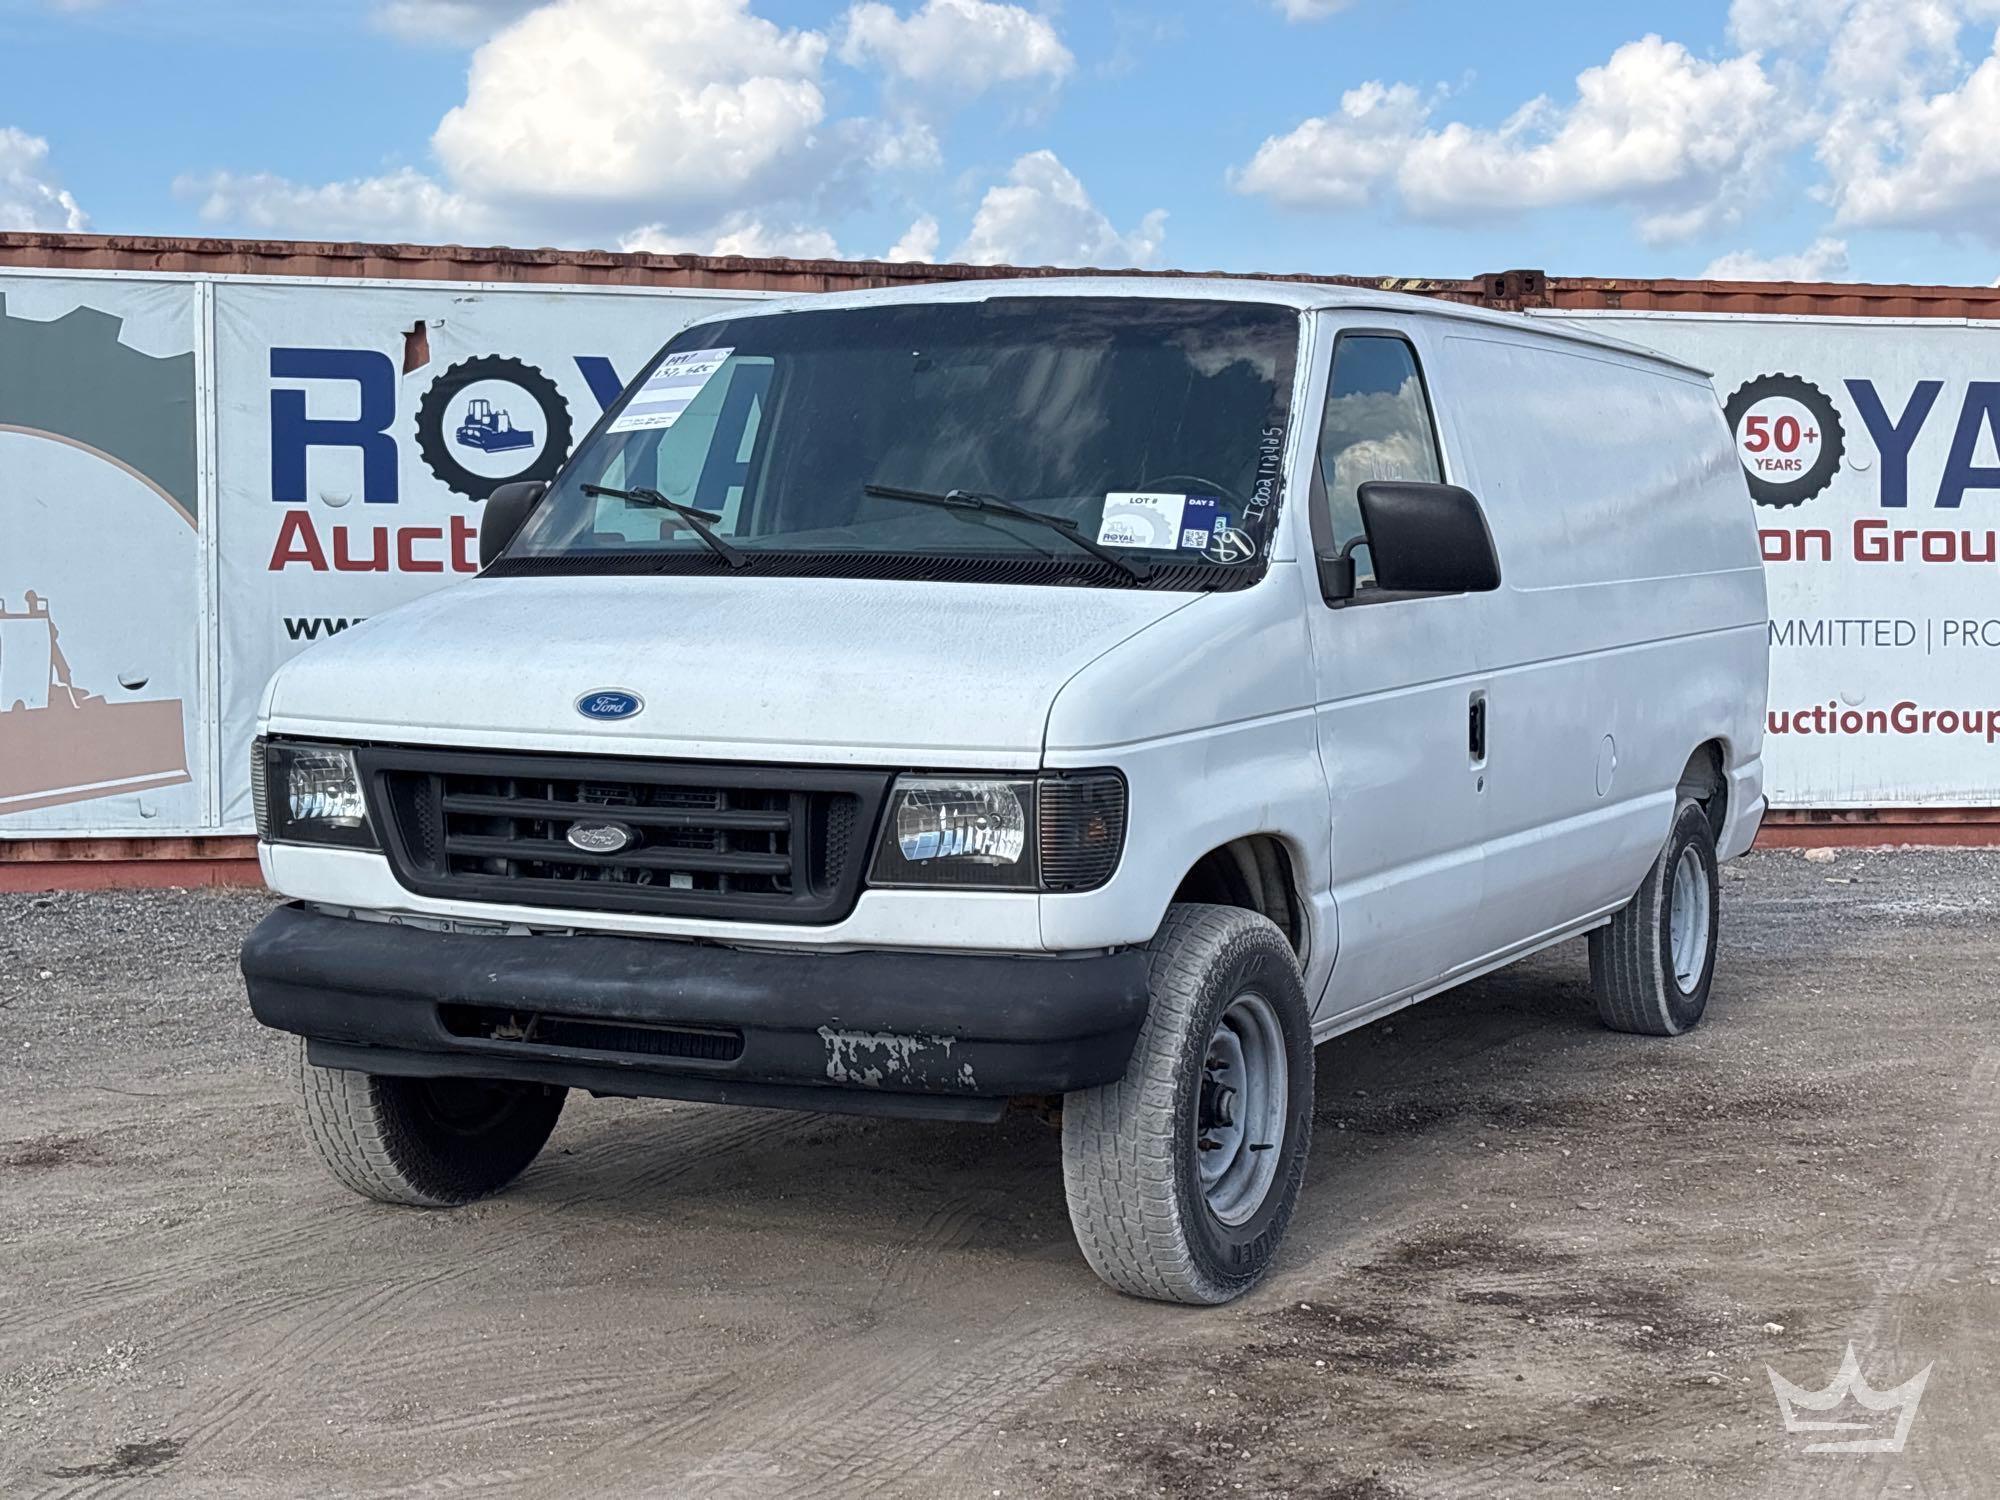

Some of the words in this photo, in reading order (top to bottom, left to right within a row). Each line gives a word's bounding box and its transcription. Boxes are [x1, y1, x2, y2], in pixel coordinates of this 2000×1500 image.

[1744, 415, 1819, 453] 50+
[1755, 458, 1803, 471] YEARS
[1188, 498, 1206, 506] DAY
[1103, 533, 1135, 542] ROYAL
[1853, 519, 1997, 563] Grou
[283, 617, 368, 641] ww
[591, 696, 627, 713] Ford
[1763, 700, 2000, 744] uctionGroup
